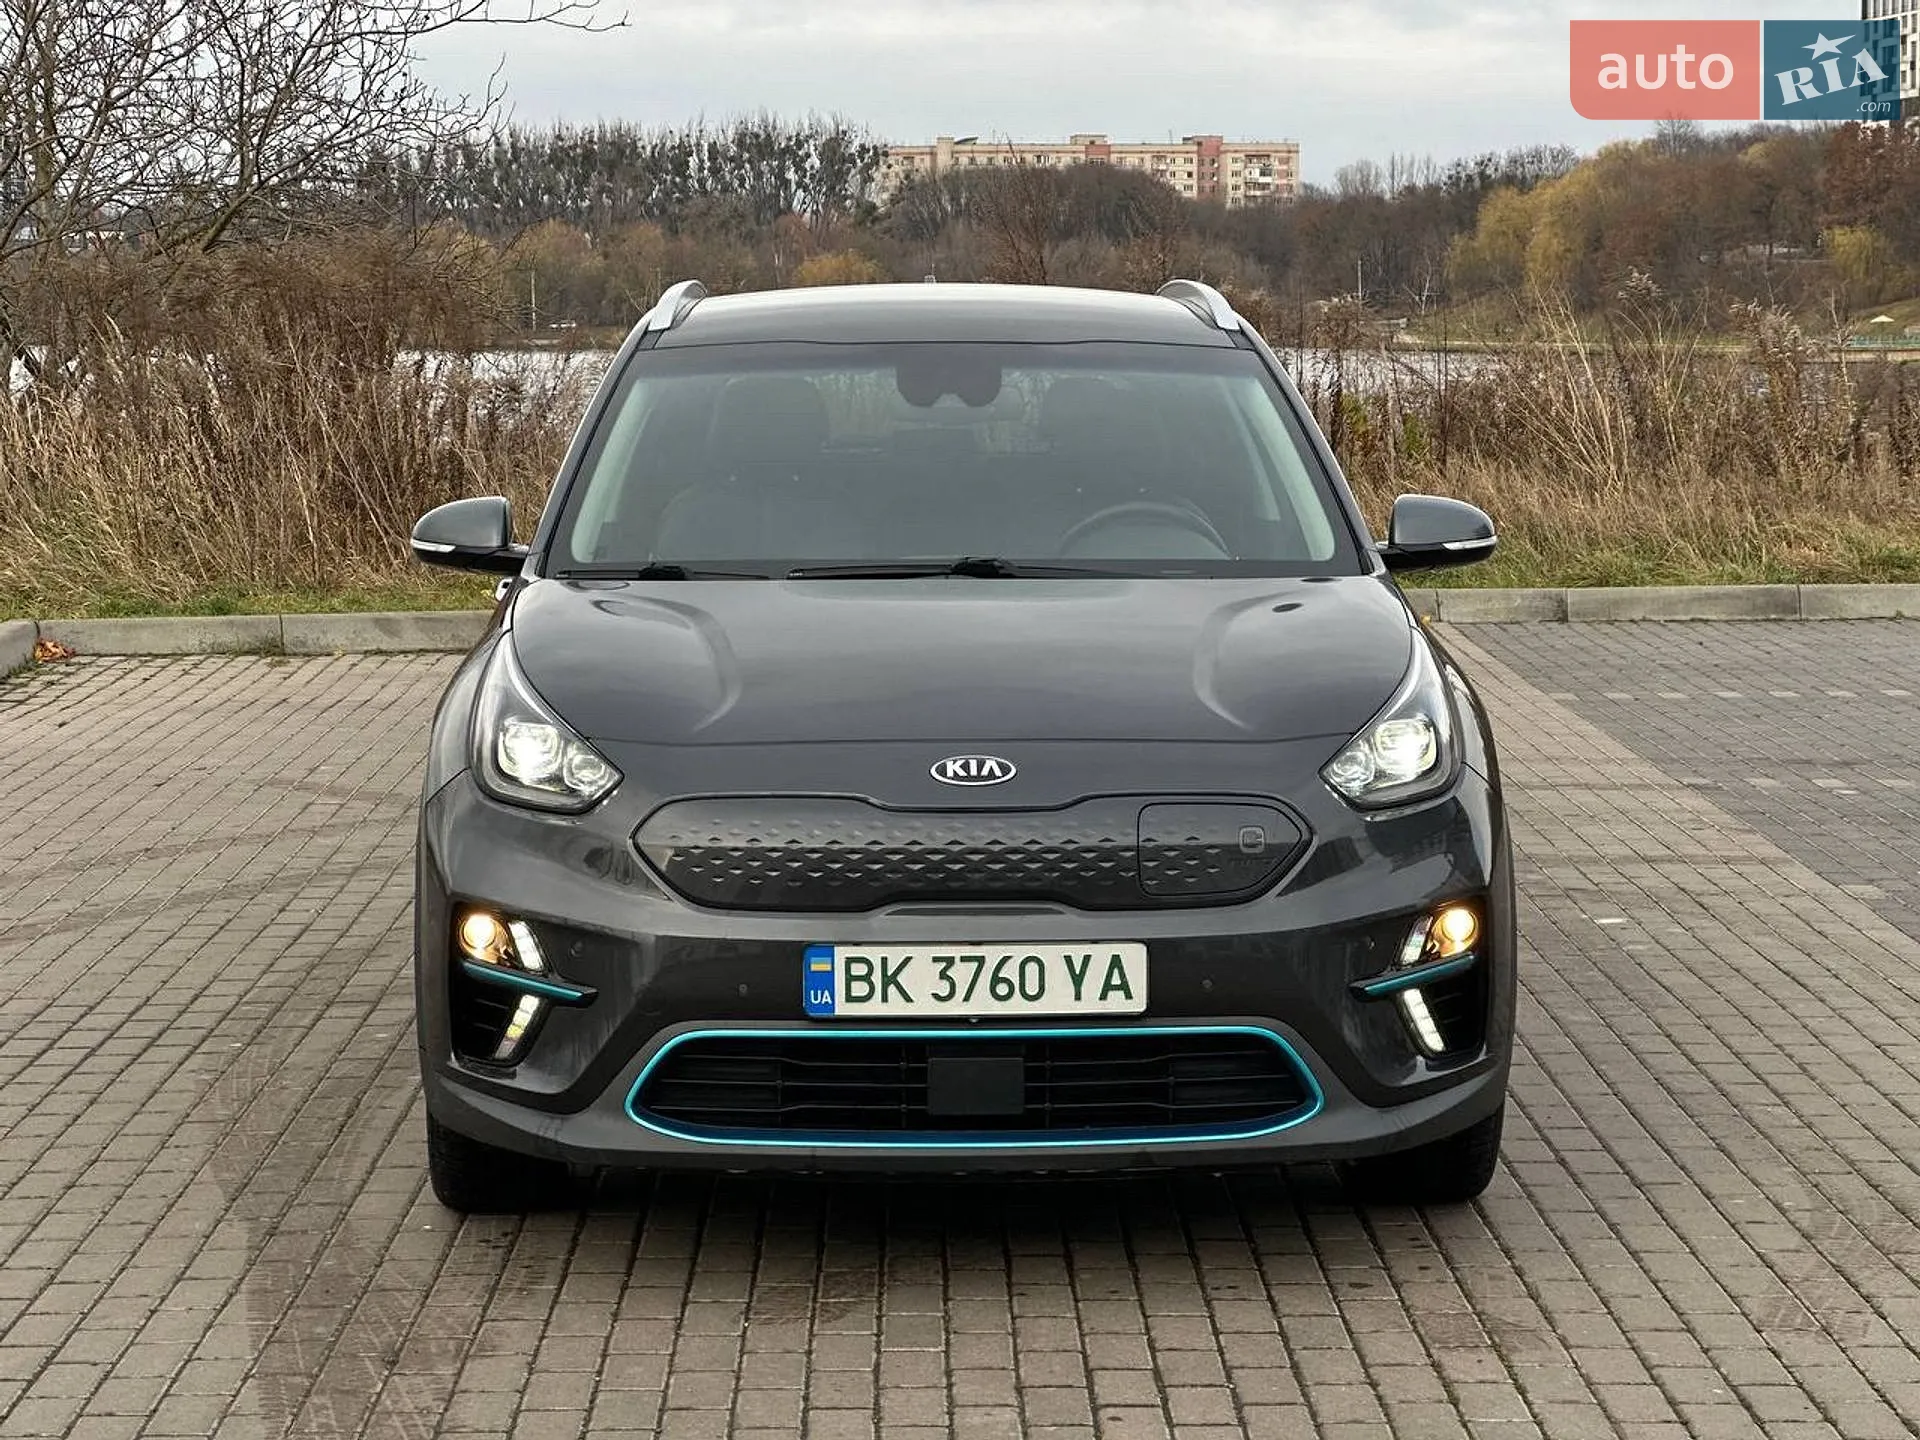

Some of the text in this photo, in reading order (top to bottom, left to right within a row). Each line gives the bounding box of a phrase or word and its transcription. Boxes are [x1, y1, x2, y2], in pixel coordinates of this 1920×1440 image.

[946, 759, 1003, 777] KIA
[844, 954, 1134, 1003] BK 3760 YA
[810, 991, 832, 1005] UA
